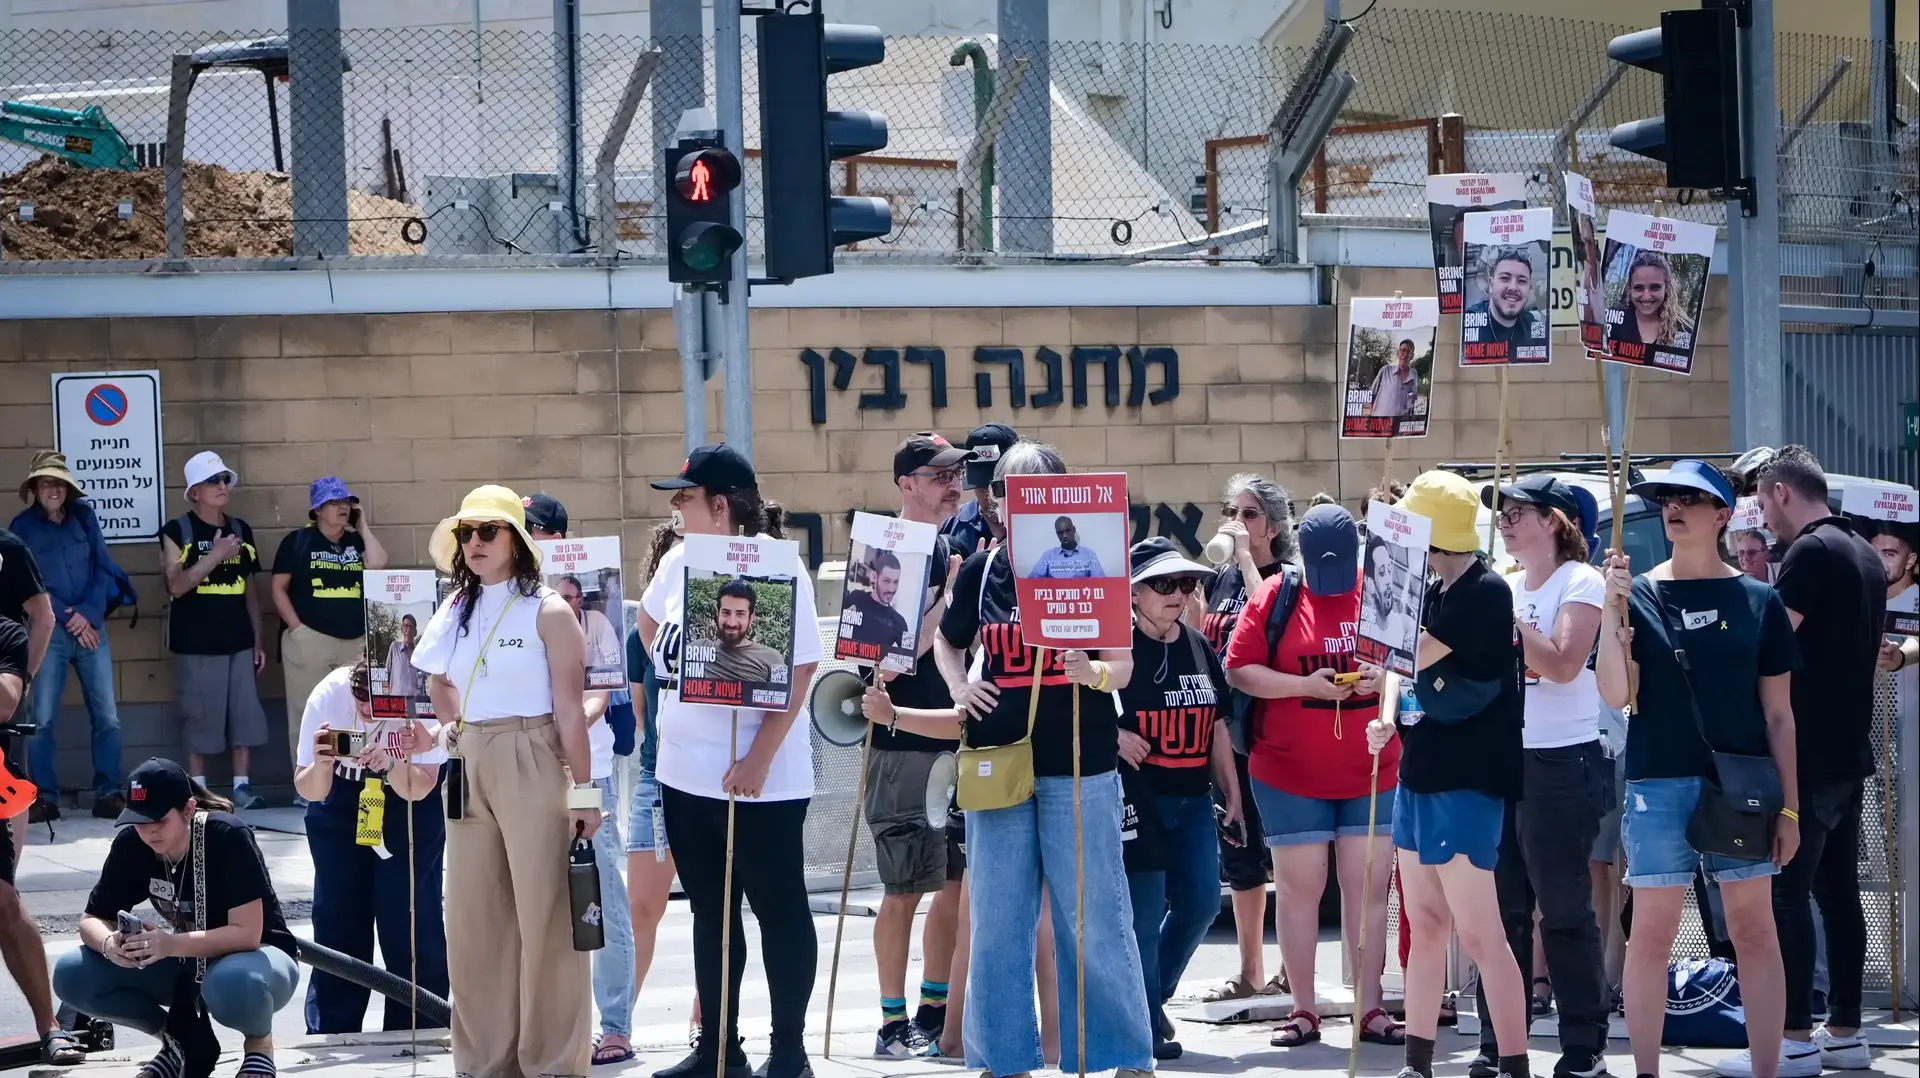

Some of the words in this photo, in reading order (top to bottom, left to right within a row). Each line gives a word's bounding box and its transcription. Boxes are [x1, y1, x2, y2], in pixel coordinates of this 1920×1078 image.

[1644, 230, 1659, 240] ROMI
[1440, 280, 1457, 293] HIM
[1441, 294, 1462, 308] HOM
[1464, 312, 1487, 328] BRING
[1604, 309, 1625, 324] RING
[1464, 327, 1479, 342] HIM
[1464, 343, 1485, 358] HOME
[1486, 340, 1509, 357] NOW!
[1619, 342, 1646, 358] NOW!
[973, 345, 1180, 409] מחנה
[800, 345, 948, 425] רבין
[1348, 389, 1373, 403] BRING
[1346, 403, 1363, 417] HIM
[1344, 417, 1369, 431] HOME
[90, 437, 130, 450] חניית
[76, 457, 142, 471] אופנועים
[79, 477, 129, 490] המדרכ
[131, 474, 153, 489] על
[1020, 486, 1047, 505] אותי
[1051, 486, 1092, 505] תשכחו
[1096, 484, 1113, 504] אל
[1874, 500, 1897, 511] EVYATAR
[1897, 502, 1914, 512] DAVID
[98, 516, 142, 530] בהחל
[551, 554, 566, 563] OHAD
[566, 553, 577, 562] BEN
[577, 553, 588, 561] AMI
[726, 553, 740, 562] IDAN
[740, 553, 760, 563] SHTIVI
[1082, 587, 1091, 600] לי
[1093, 588, 1105, 600] גם
[1046, 602, 1067, 614] שנים
[1068, 602, 1075, 614] 9
[1077, 602, 1093, 614] כבר
[841, 608, 863, 626] BRING
[1690, 615, 1711, 626] 02
[839, 623, 854, 639] HIM
[498, 638, 524, 648] 202
[837, 640, 858, 655] HOME
[859, 643, 881, 659] NOW!
[685, 645, 717, 663] BRING
[370, 667, 388, 682] BRING
[684, 661, 705, 678] HIM
[371, 681, 384, 696] HIM
[683, 679, 712, 696] HOME
[714, 681, 743, 699] NOW!
[1163, 690, 1195, 707] הביתה
